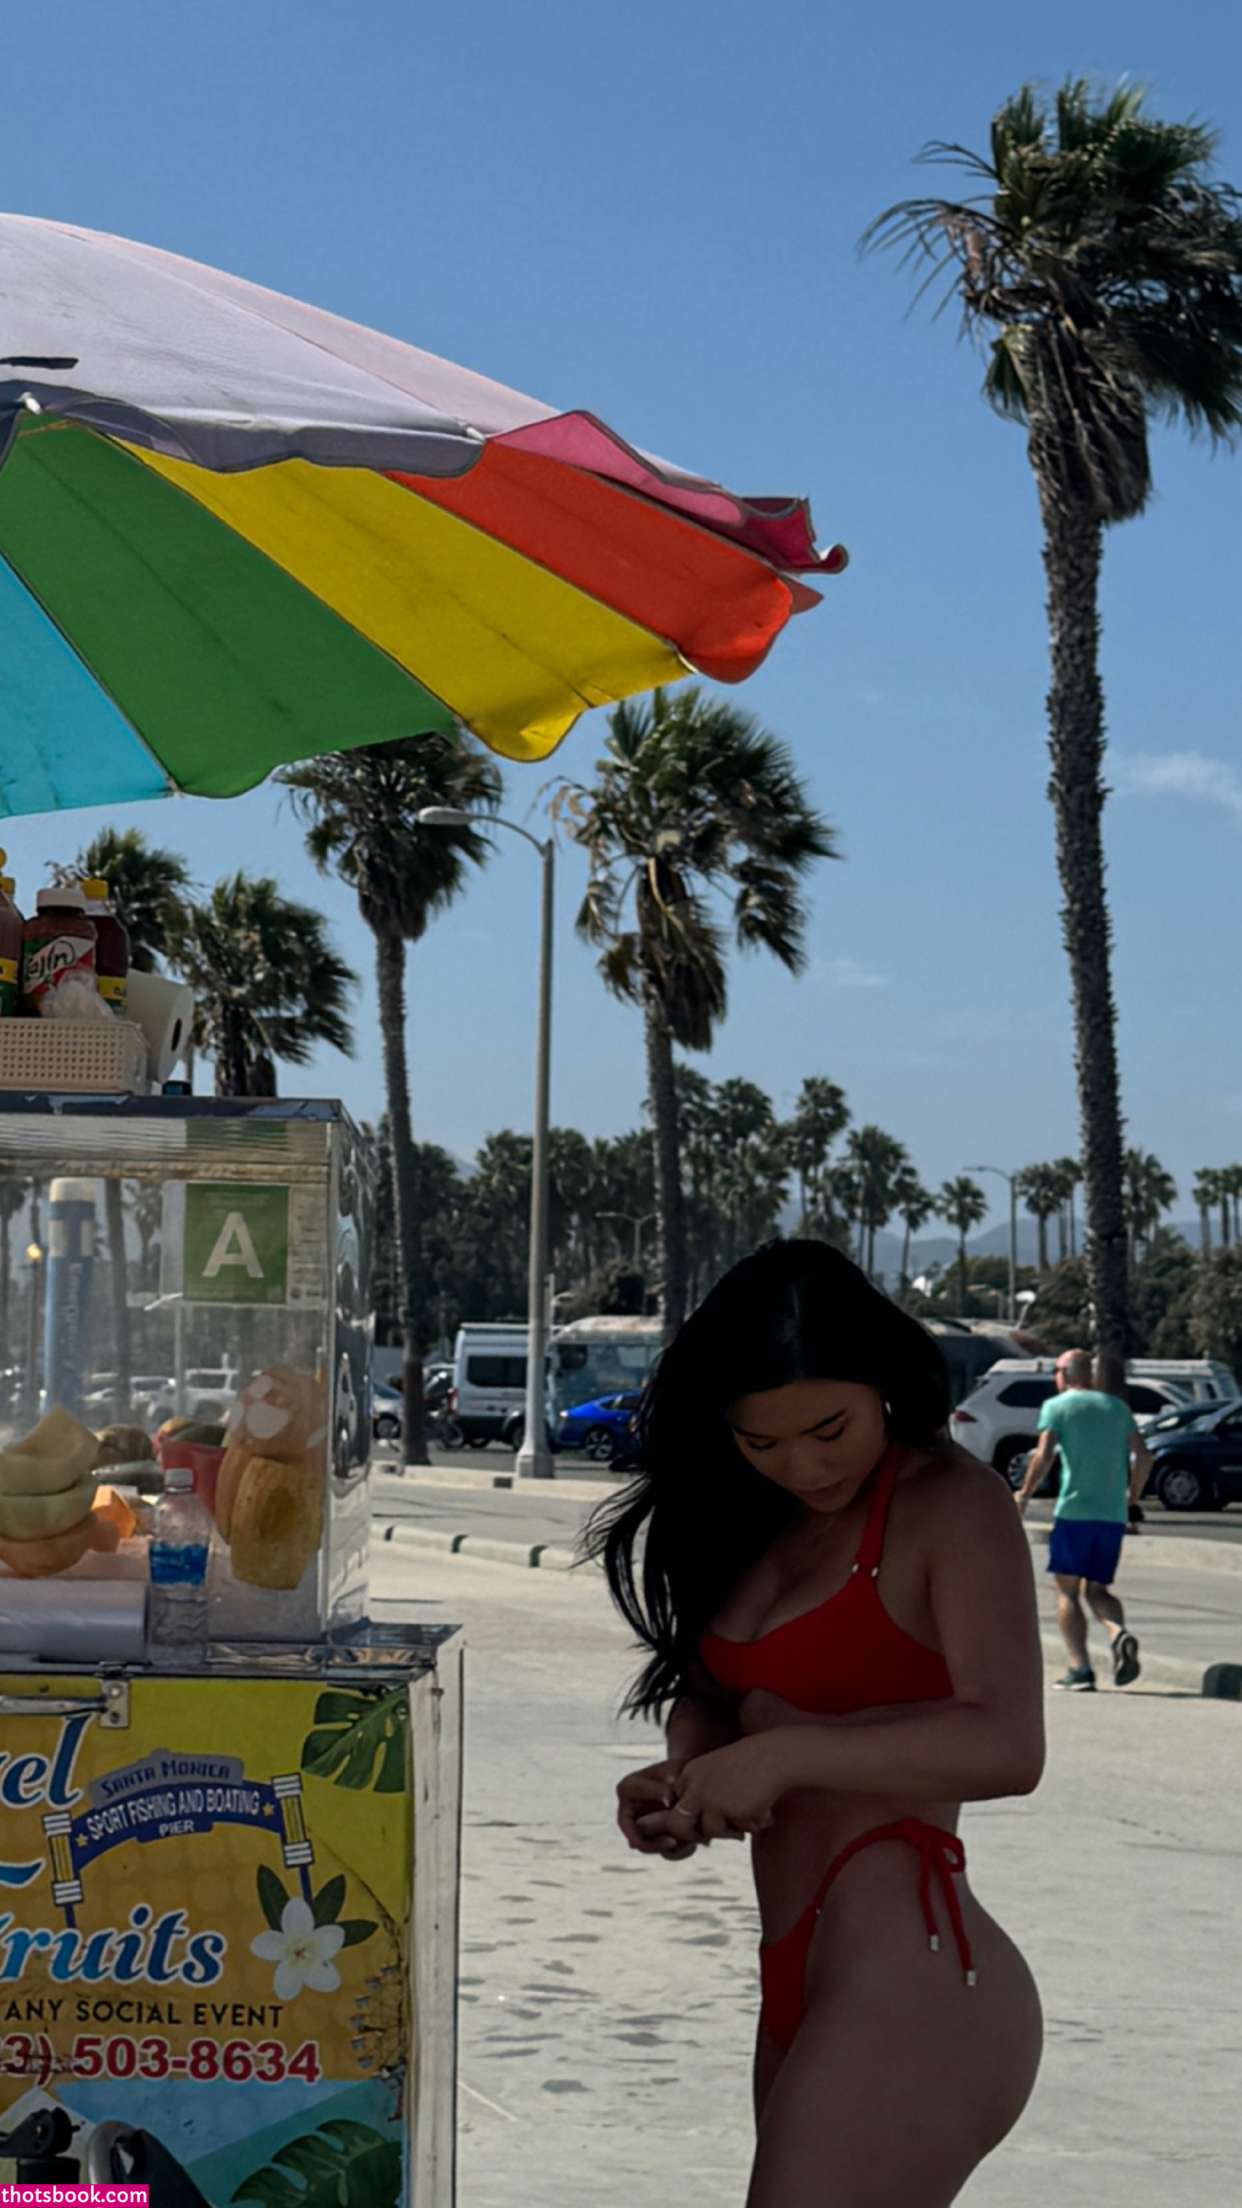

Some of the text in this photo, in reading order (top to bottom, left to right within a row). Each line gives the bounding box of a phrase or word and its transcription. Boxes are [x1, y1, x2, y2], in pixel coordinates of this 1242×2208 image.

[201, 1211, 265, 1278] A
[0, 1713, 90, 1808] el
[101, 1759, 231, 1797] SANTA MONICA
[87, 1787, 261, 1839] SPORT FISHING AND BOATING
[158, 1819, 196, 1837] PIER
[0, 1903, 228, 1987] ruits
[4, 1999, 285, 2028] ANY SOCIAL EVENT
[72, 2033, 323, 2086] 503-8634
